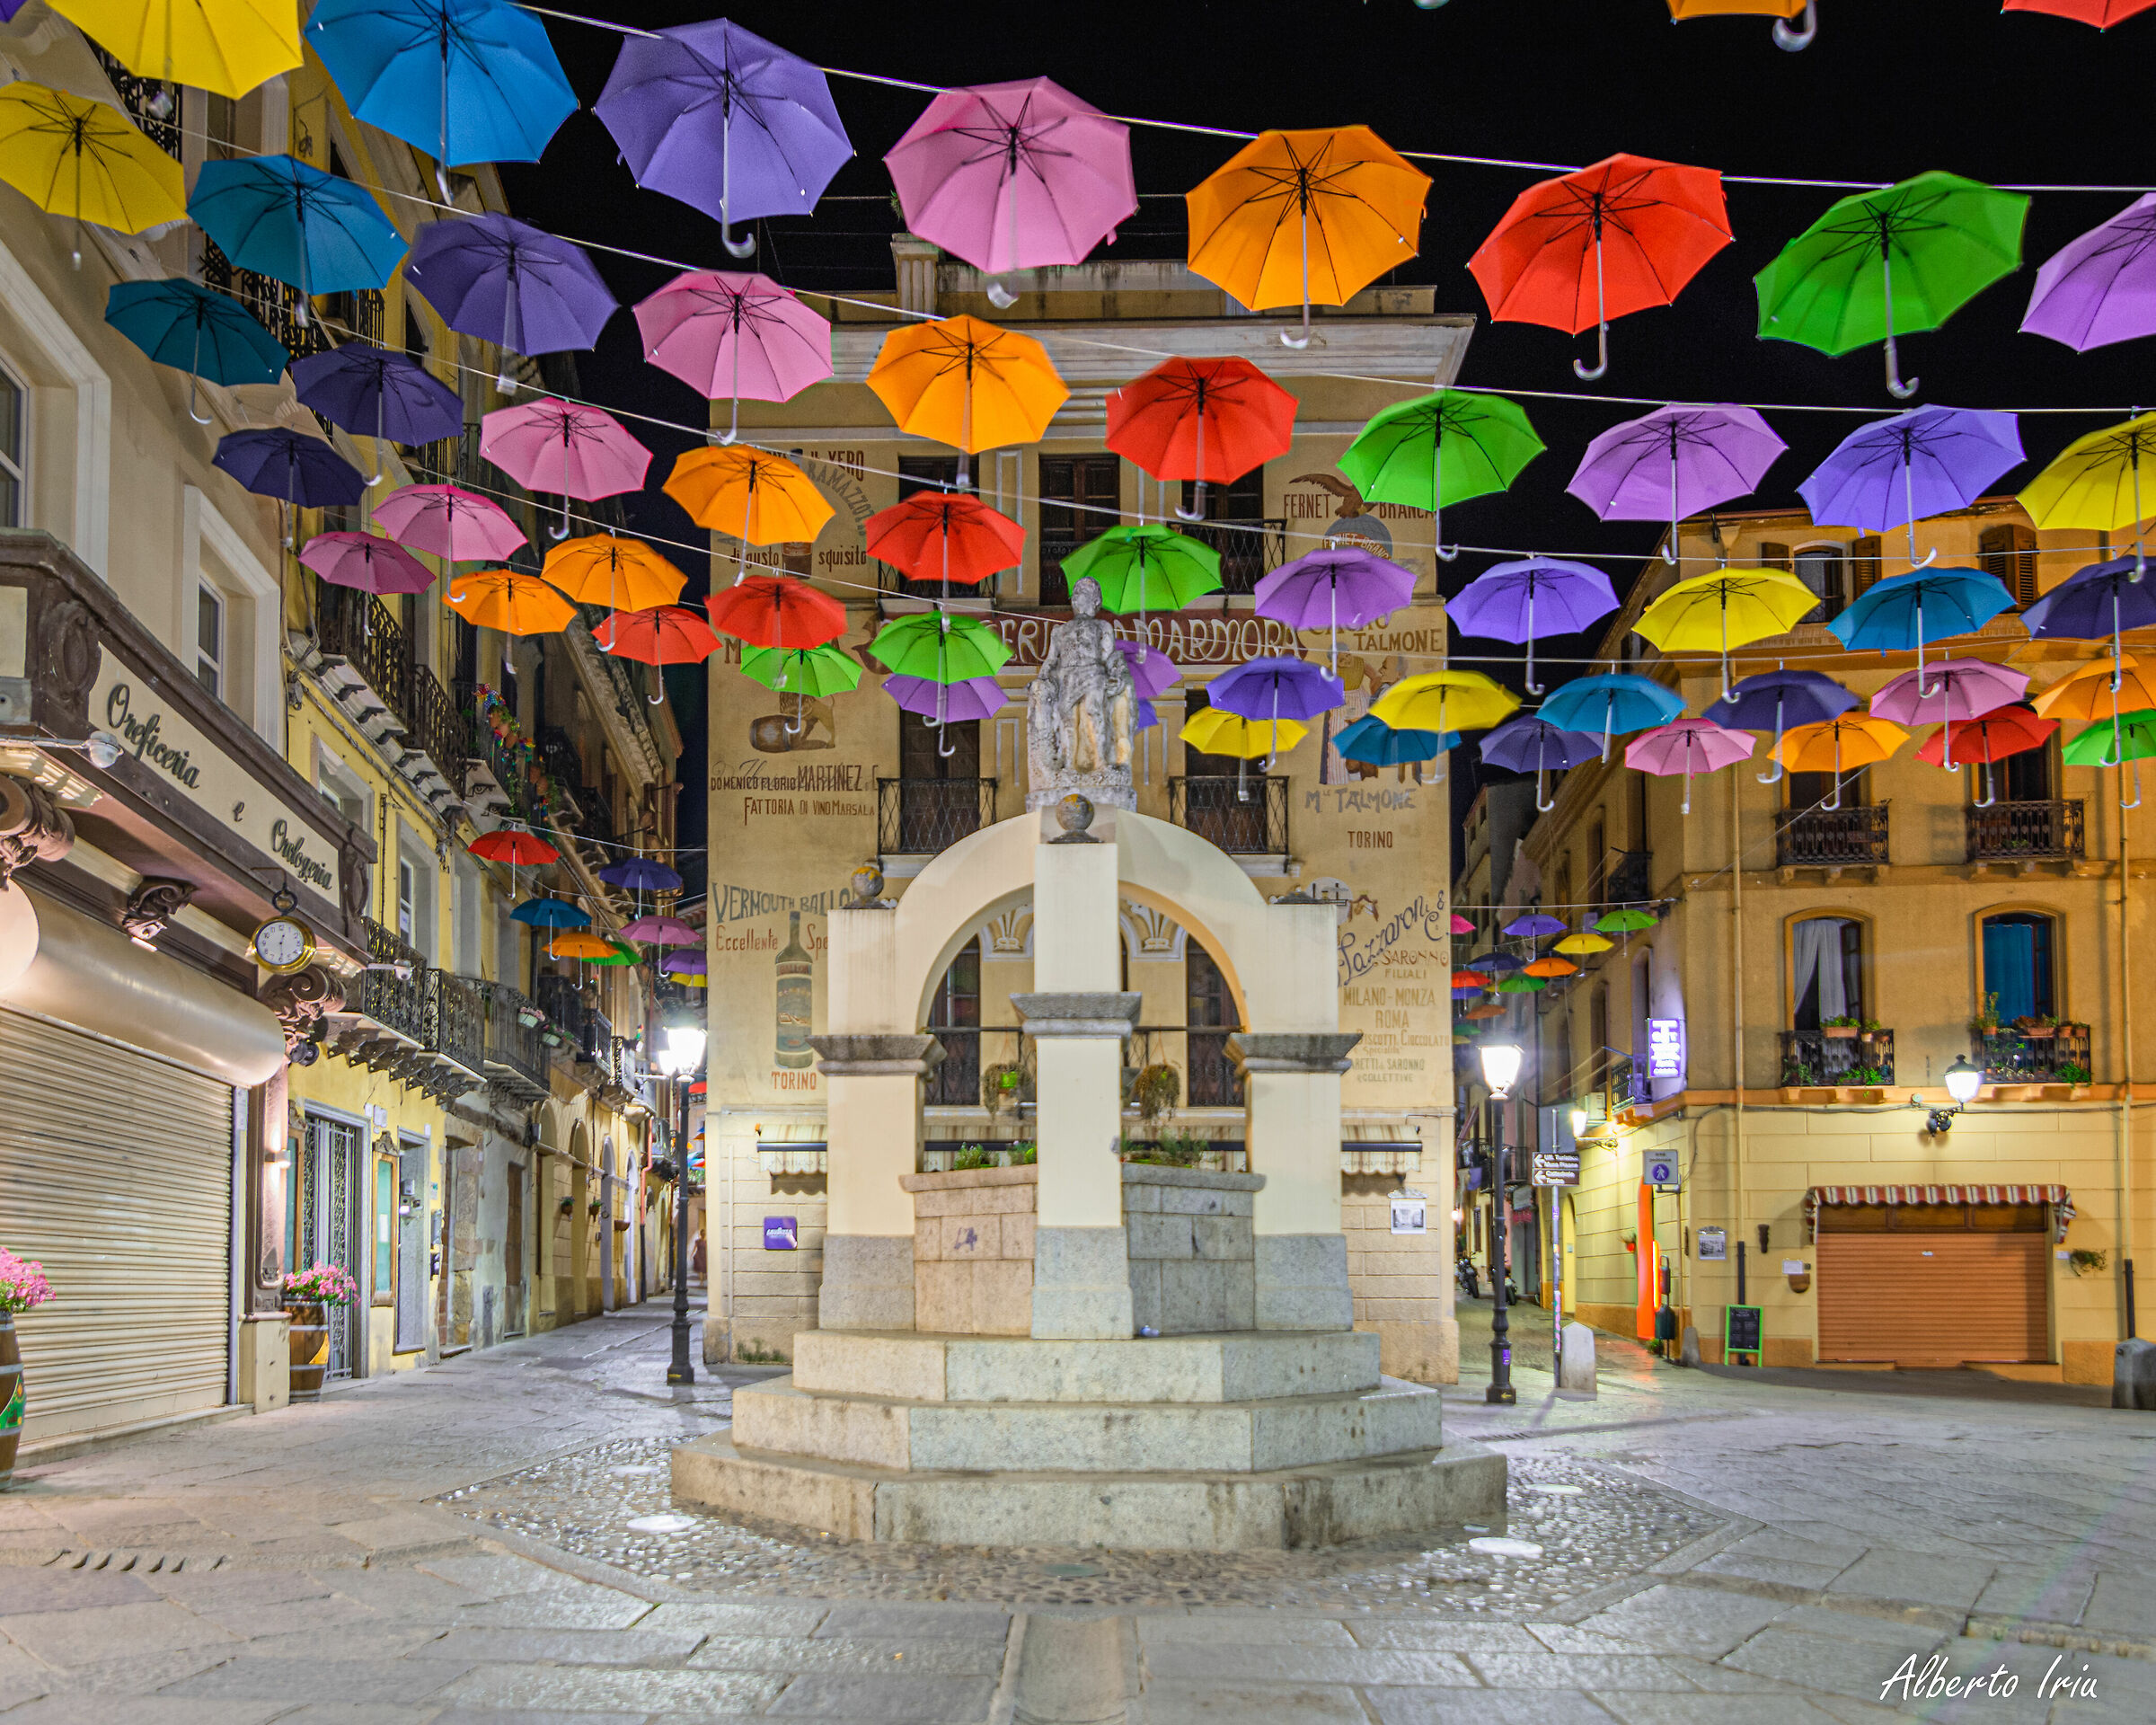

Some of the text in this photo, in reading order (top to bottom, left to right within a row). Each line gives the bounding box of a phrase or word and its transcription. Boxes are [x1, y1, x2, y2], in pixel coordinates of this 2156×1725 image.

[828, 450, 864, 482] VERO
[1284, 494, 1330, 518] FERNET
[730, 546, 779, 569] di gusto
[818, 545, 867, 572] squisito
[1353, 629, 1443, 652] TALMONE
[107, 683, 199, 790] Oreficeria
[272, 818, 332, 889] Orologeria
[711, 776, 758, 792] DOMENICO
[761, 776, 796, 792] FLORIO
[797, 765, 862, 792] MARTINEZ
[745, 797, 795, 826] FATTORIA
[813, 800, 831, 815] VINO
[832, 800, 875, 816] MARSALA
[1335, 788, 1417, 813] TALMONE
[1348, 831, 1392, 848] TORINO
[711, 882, 794, 924] VERMOUTH
[716, 923, 828, 960] Eccellente Spe
[1381, 950, 1449, 968] SARONNO
[1384, 969, 1427, 978] FILIALI
[1343, 987, 1385, 1006] MILANO
[1395, 987, 1436, 1006] MONZA
[1375, 1010, 1409, 1029] ROMA
[1401, 1030, 1450, 1047] CIOCCOLATO
[1387, 1058, 1425, 1071] SARONNO
[772, 1071, 817, 1090] TORINO
